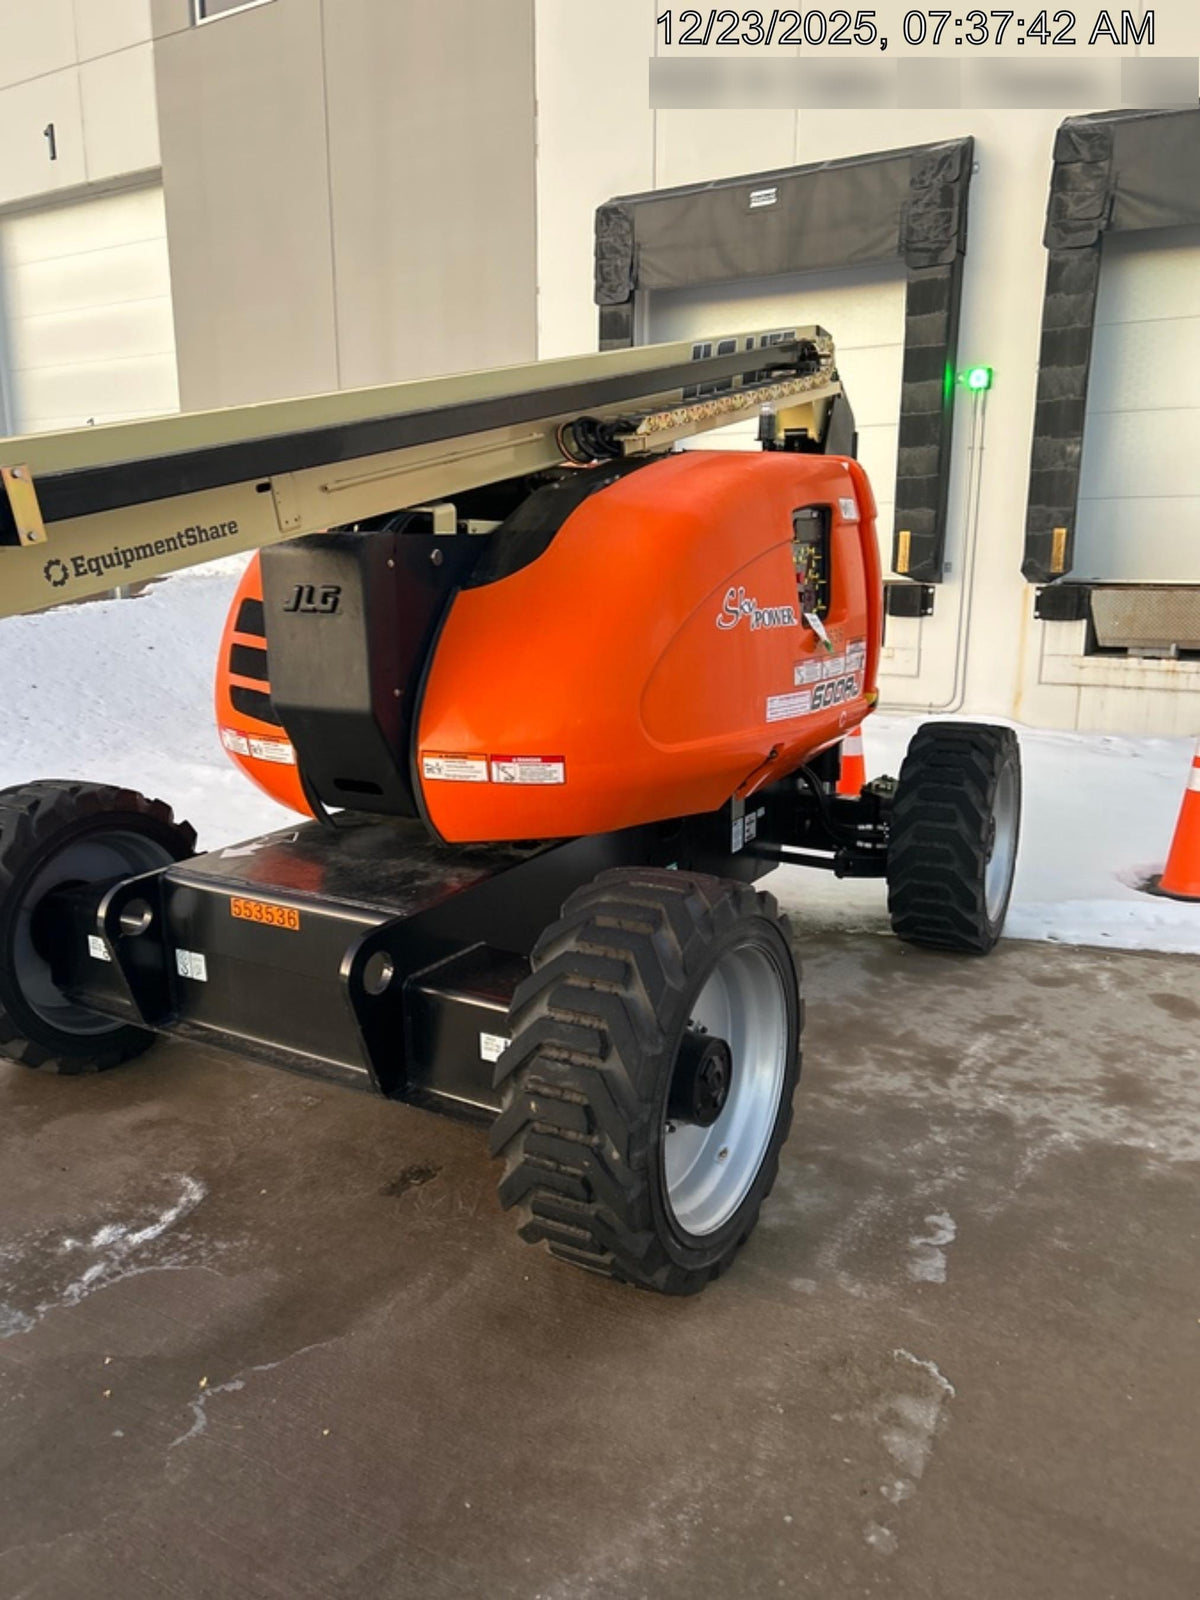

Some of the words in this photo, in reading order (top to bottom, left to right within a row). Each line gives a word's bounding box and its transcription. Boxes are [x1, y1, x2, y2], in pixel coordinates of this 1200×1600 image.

[43, 123, 57, 161] 1
[71, 520, 239, 578] EquipmentShare
[283, 584, 342, 614] JLG
[716, 586, 757, 630] Sky
[753, 606, 798, 630] POWER
[232, 898, 298, 929] 553536
